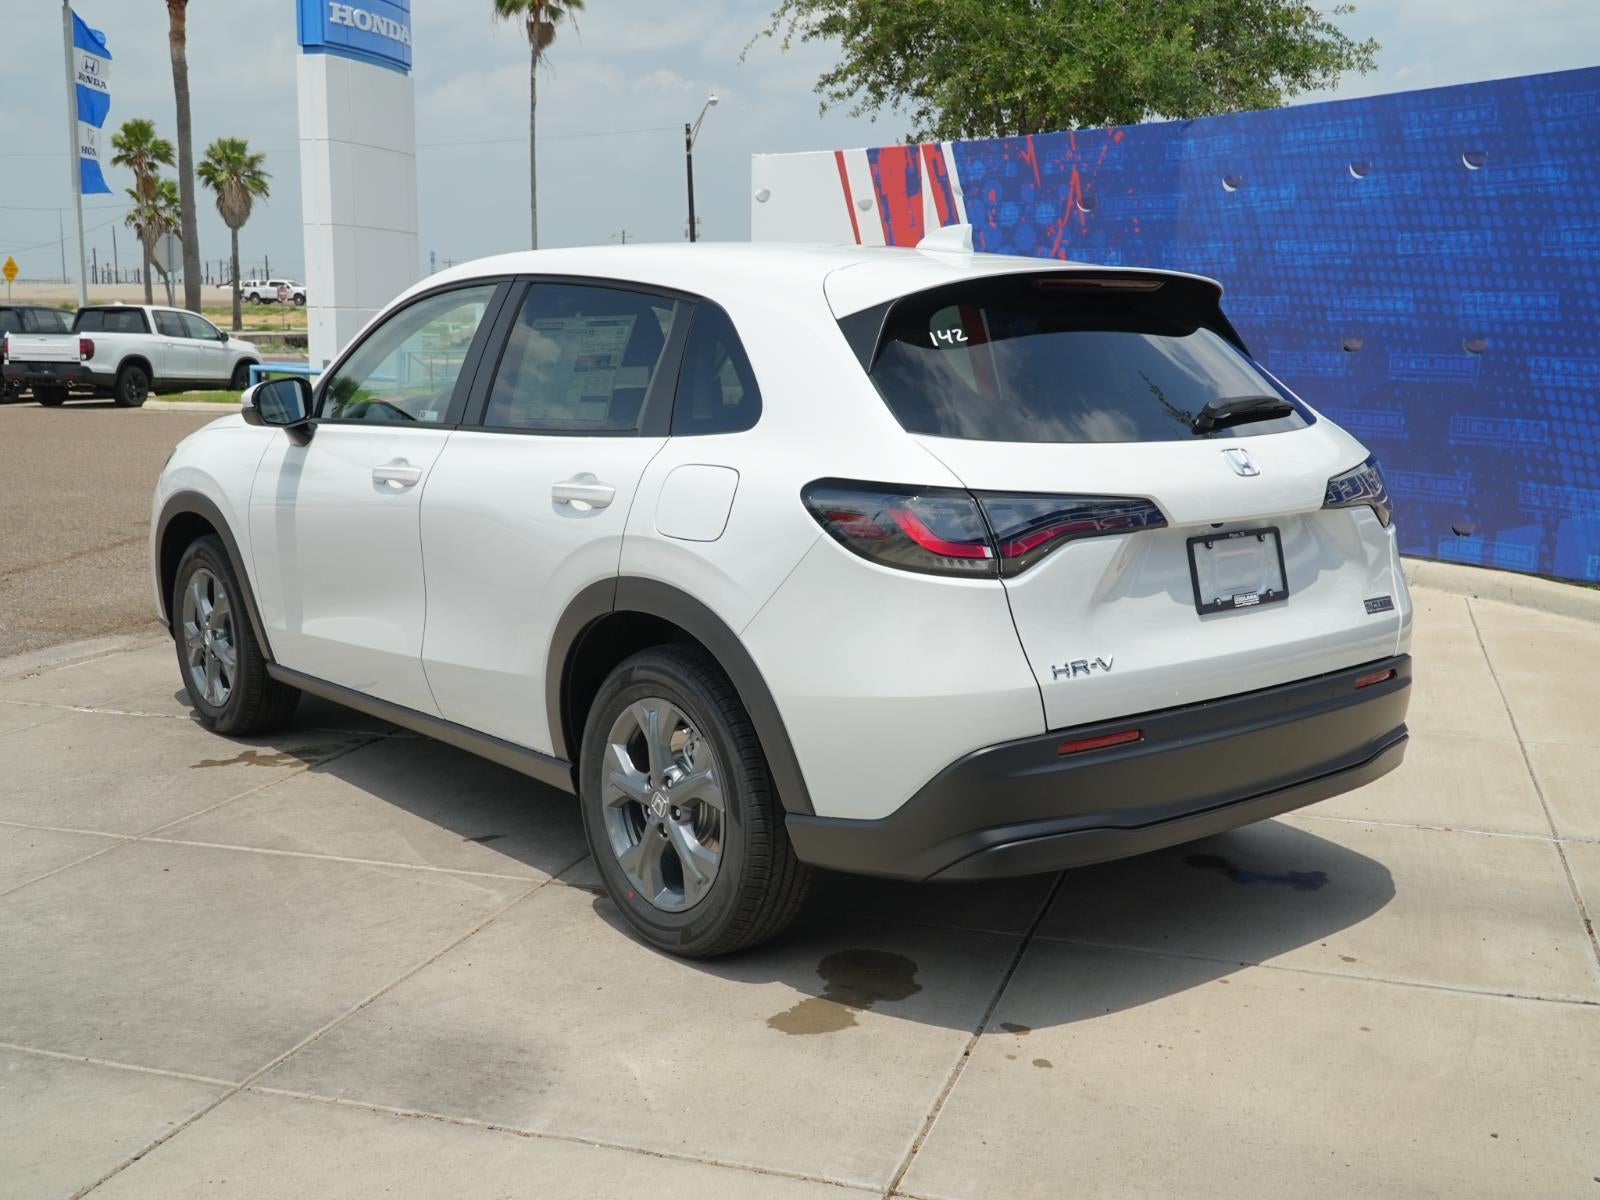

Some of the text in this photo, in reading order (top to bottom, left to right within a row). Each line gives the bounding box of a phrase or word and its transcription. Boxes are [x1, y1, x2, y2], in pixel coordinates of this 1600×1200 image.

[329, 2, 411, 48] HONDA
[929, 328, 969, 347] 142
[1051, 656, 1113, 680] HR-V
